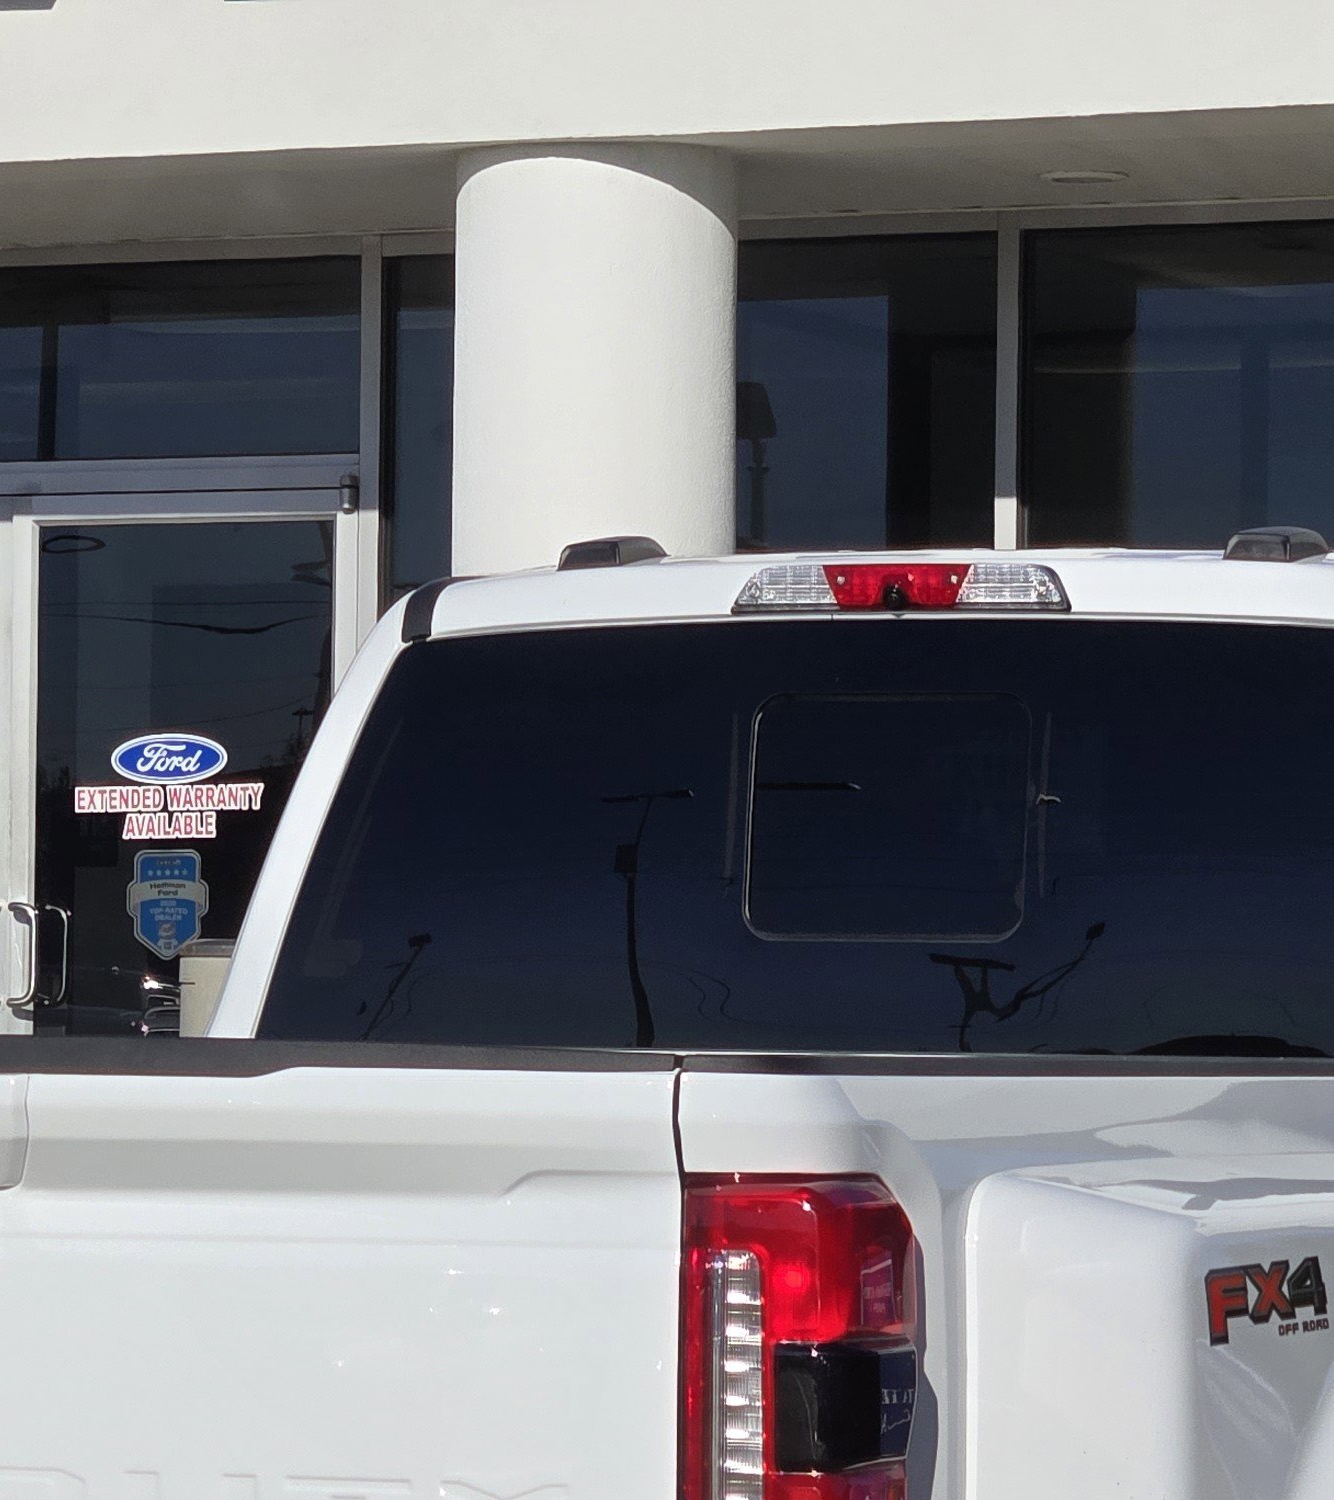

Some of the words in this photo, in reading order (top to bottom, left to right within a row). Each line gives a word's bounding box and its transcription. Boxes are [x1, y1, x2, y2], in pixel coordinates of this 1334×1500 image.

[136, 743, 201, 772] Ford
[77, 787, 162, 811] EXTENDED
[168, 785, 263, 810] WARRANTY
[124, 815, 214, 837] AVAILABLE
[1204, 1256, 1328, 1346] FX4
[1278, 1322, 1299, 1337] OFF
[1302, 1318, 1330, 1333] ROAD
